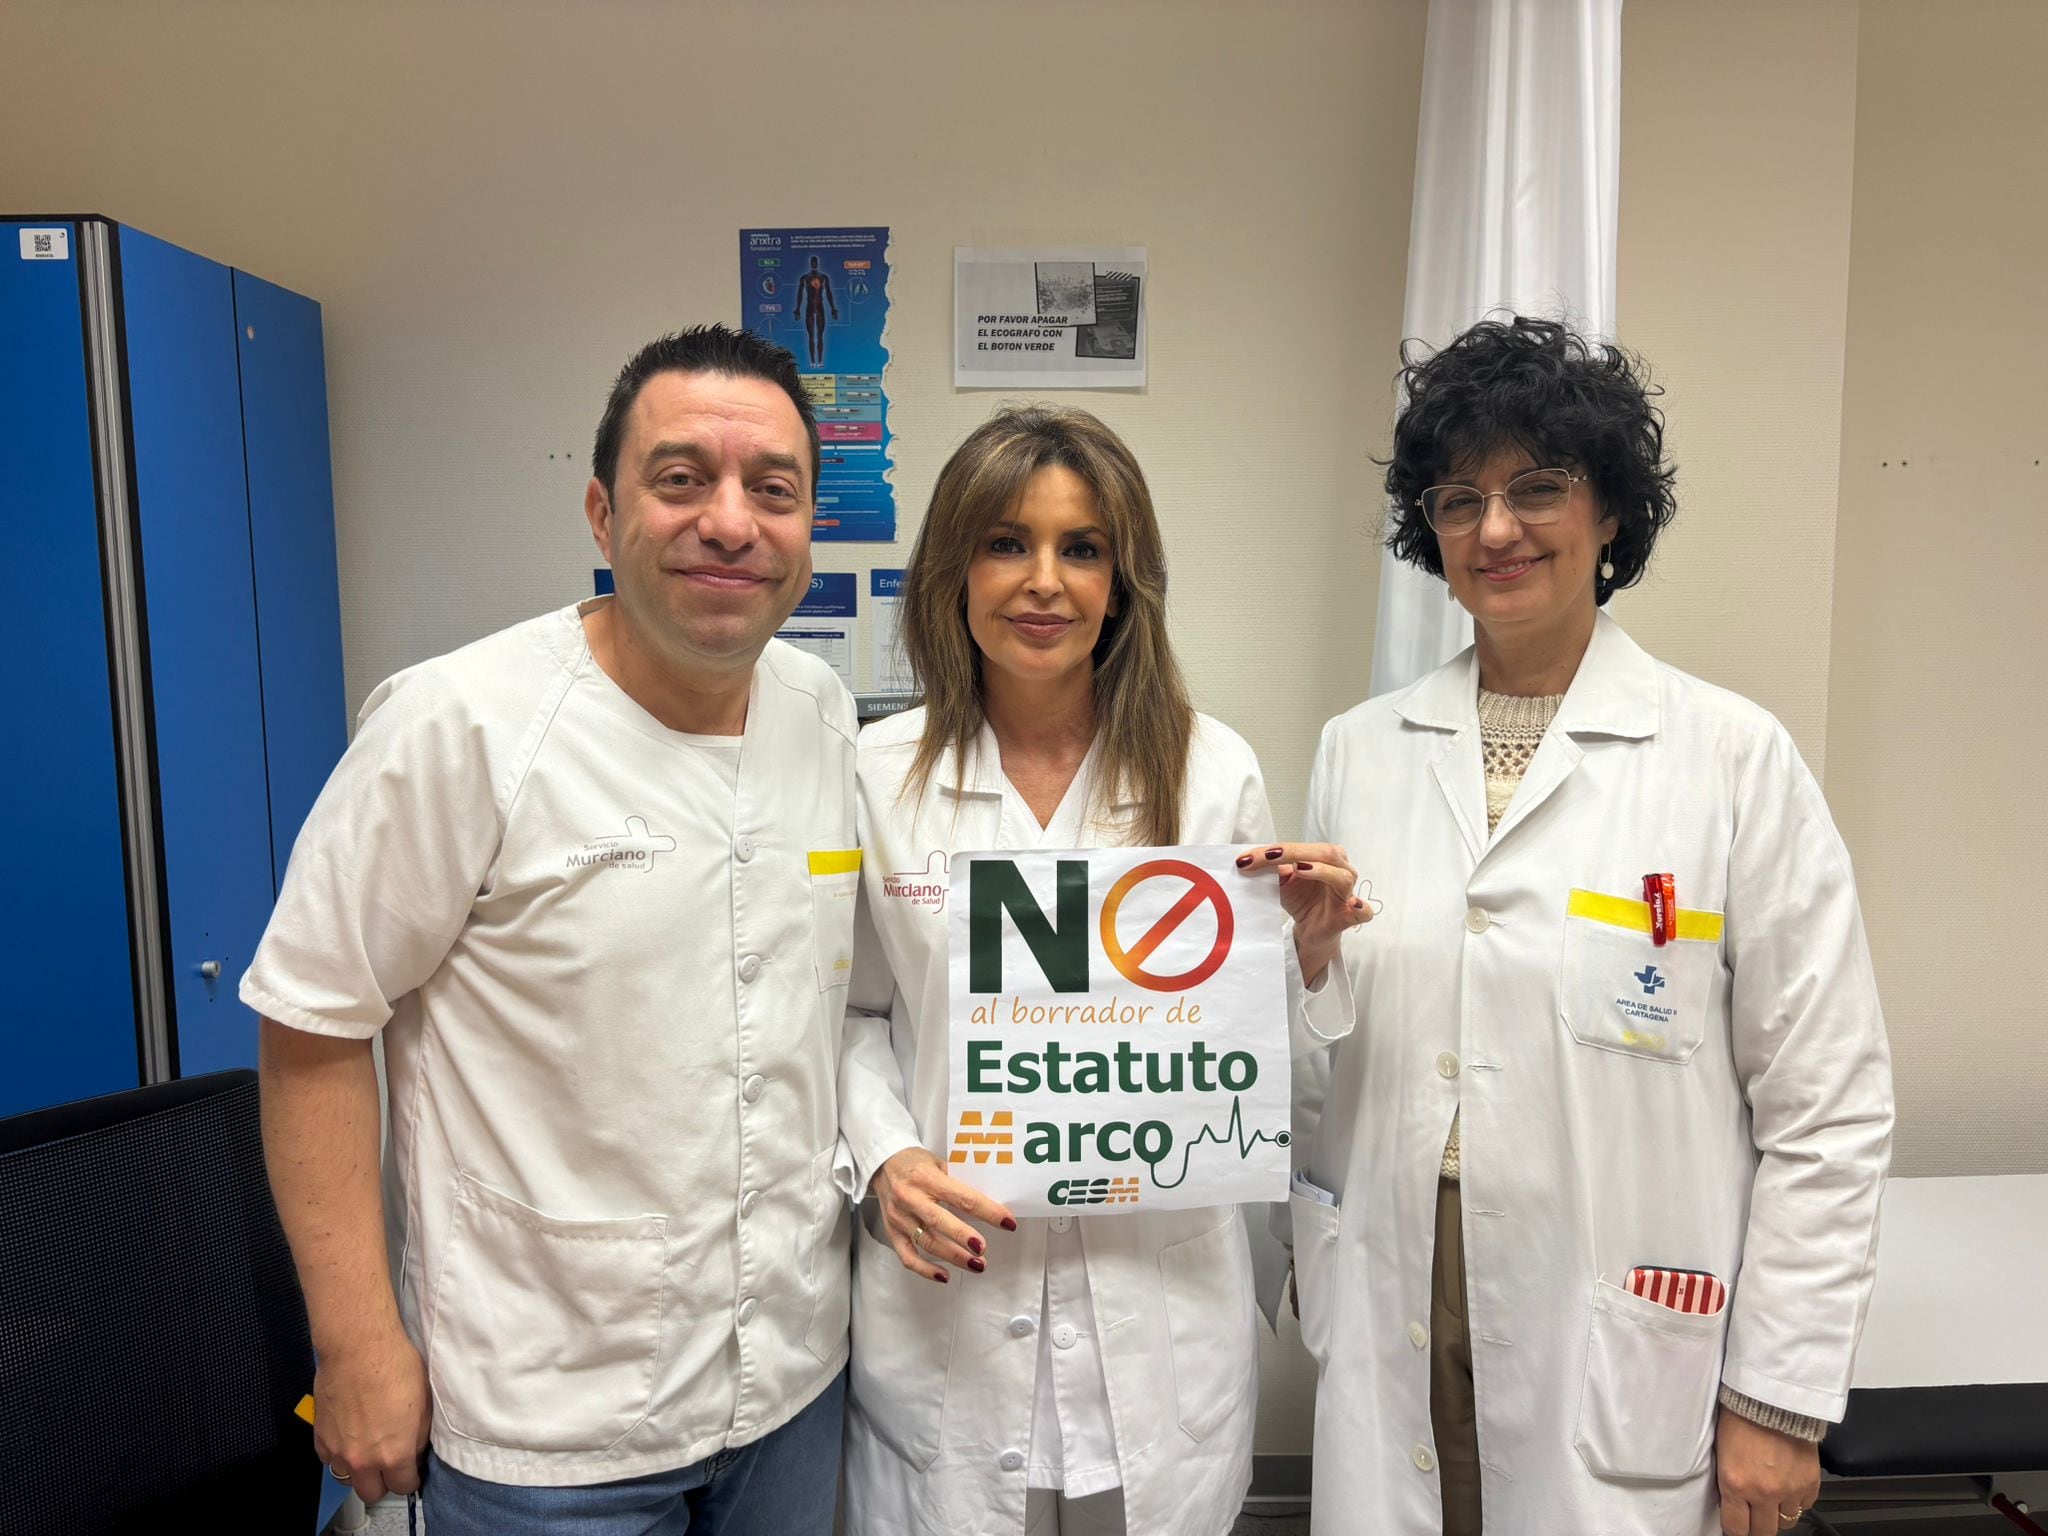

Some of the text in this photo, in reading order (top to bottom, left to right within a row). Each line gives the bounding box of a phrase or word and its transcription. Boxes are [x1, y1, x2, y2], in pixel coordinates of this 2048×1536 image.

[978, 315, 1068, 324] POR FAVOR APAGAR
[978, 329, 988, 337] EL
[991, 329, 1040, 337] ECOGRAFO
[978, 342, 988, 350] EL
[880, 579, 904, 588] Enfe
[584, 841, 619, 851] Servicio
[566, 849, 646, 868] Murciano
[970, 997, 1201, 1024] al borrador de
[1616, 999, 1636, 1008] AREA
[1649, 1005, 1672, 1015] SALUD
[1625, 1009, 1668, 1022] CARTAGENA
[966, 1040, 1258, 1093] Estatuto
[948, 1111, 1173, 1164] Marco
[1047, 1177, 1139, 1206] CESM
